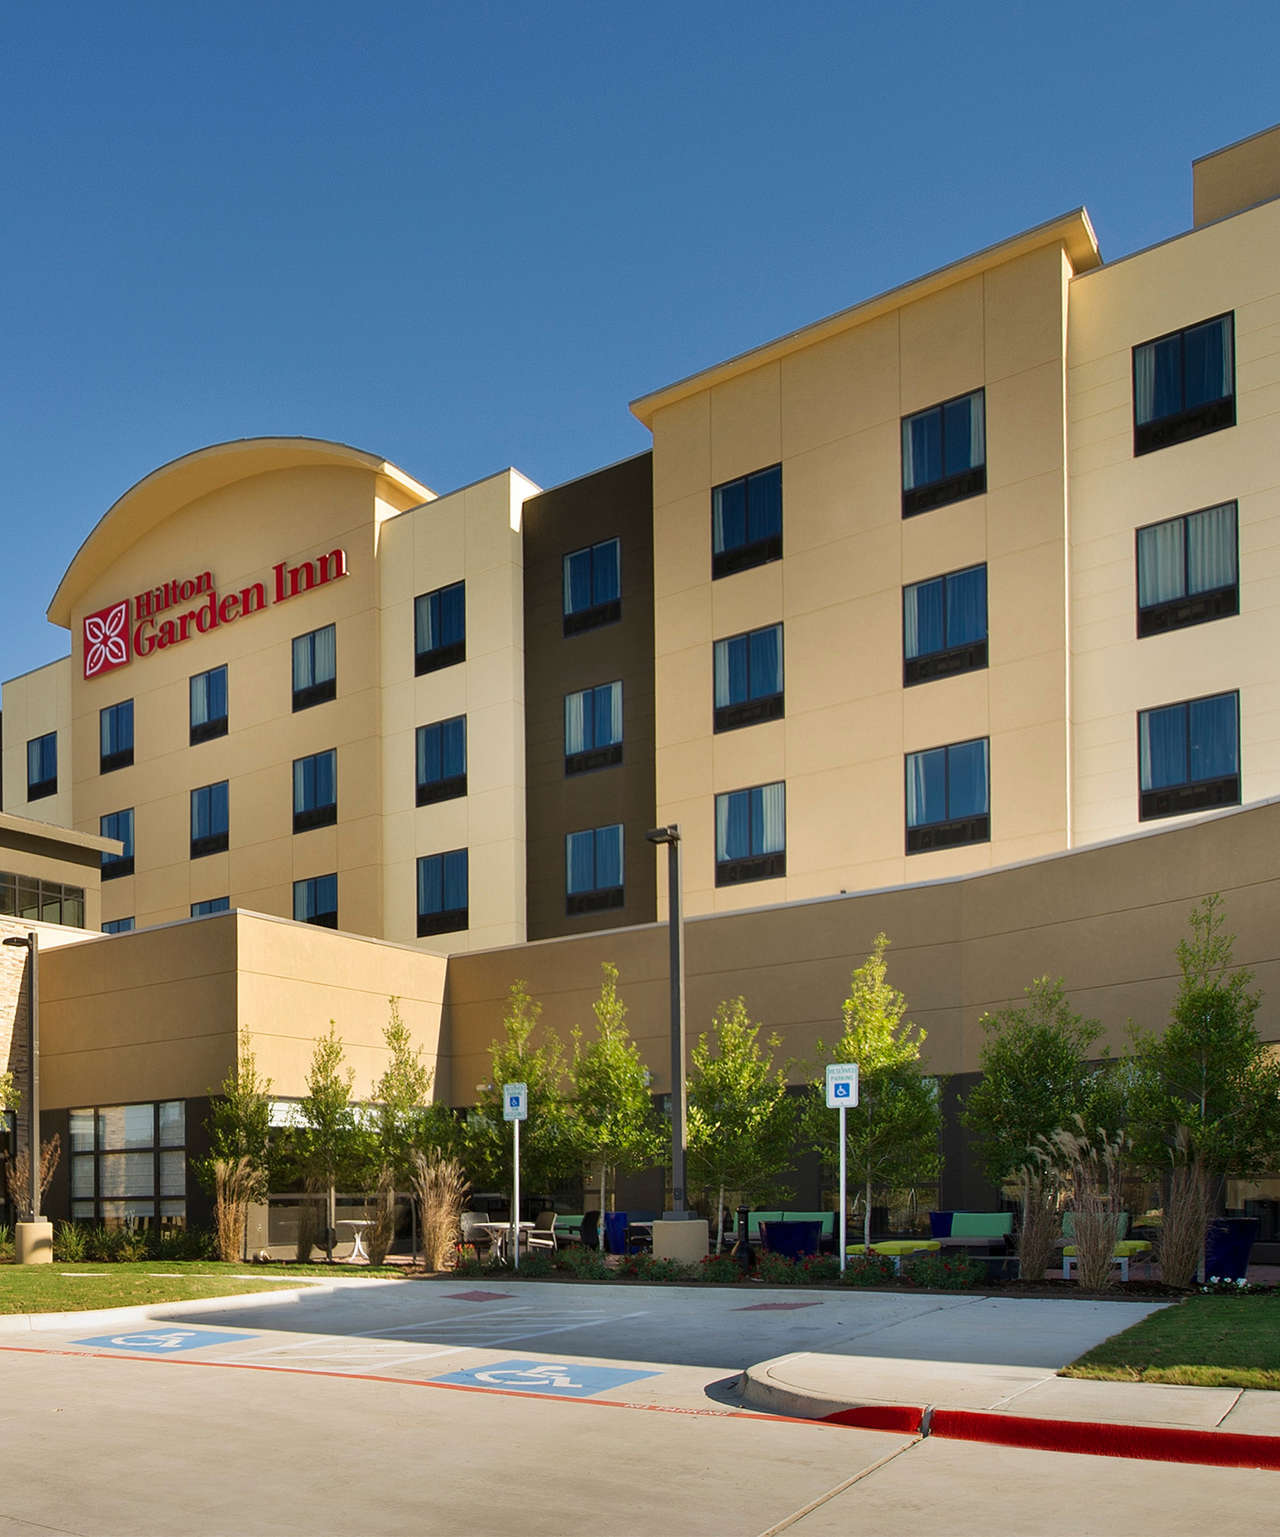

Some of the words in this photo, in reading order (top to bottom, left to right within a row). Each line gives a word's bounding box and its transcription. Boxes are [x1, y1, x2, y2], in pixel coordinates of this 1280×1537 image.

[134, 571, 213, 620] Hilton
[134, 581, 267, 657] Garden
[272, 548, 350, 604] Inn
